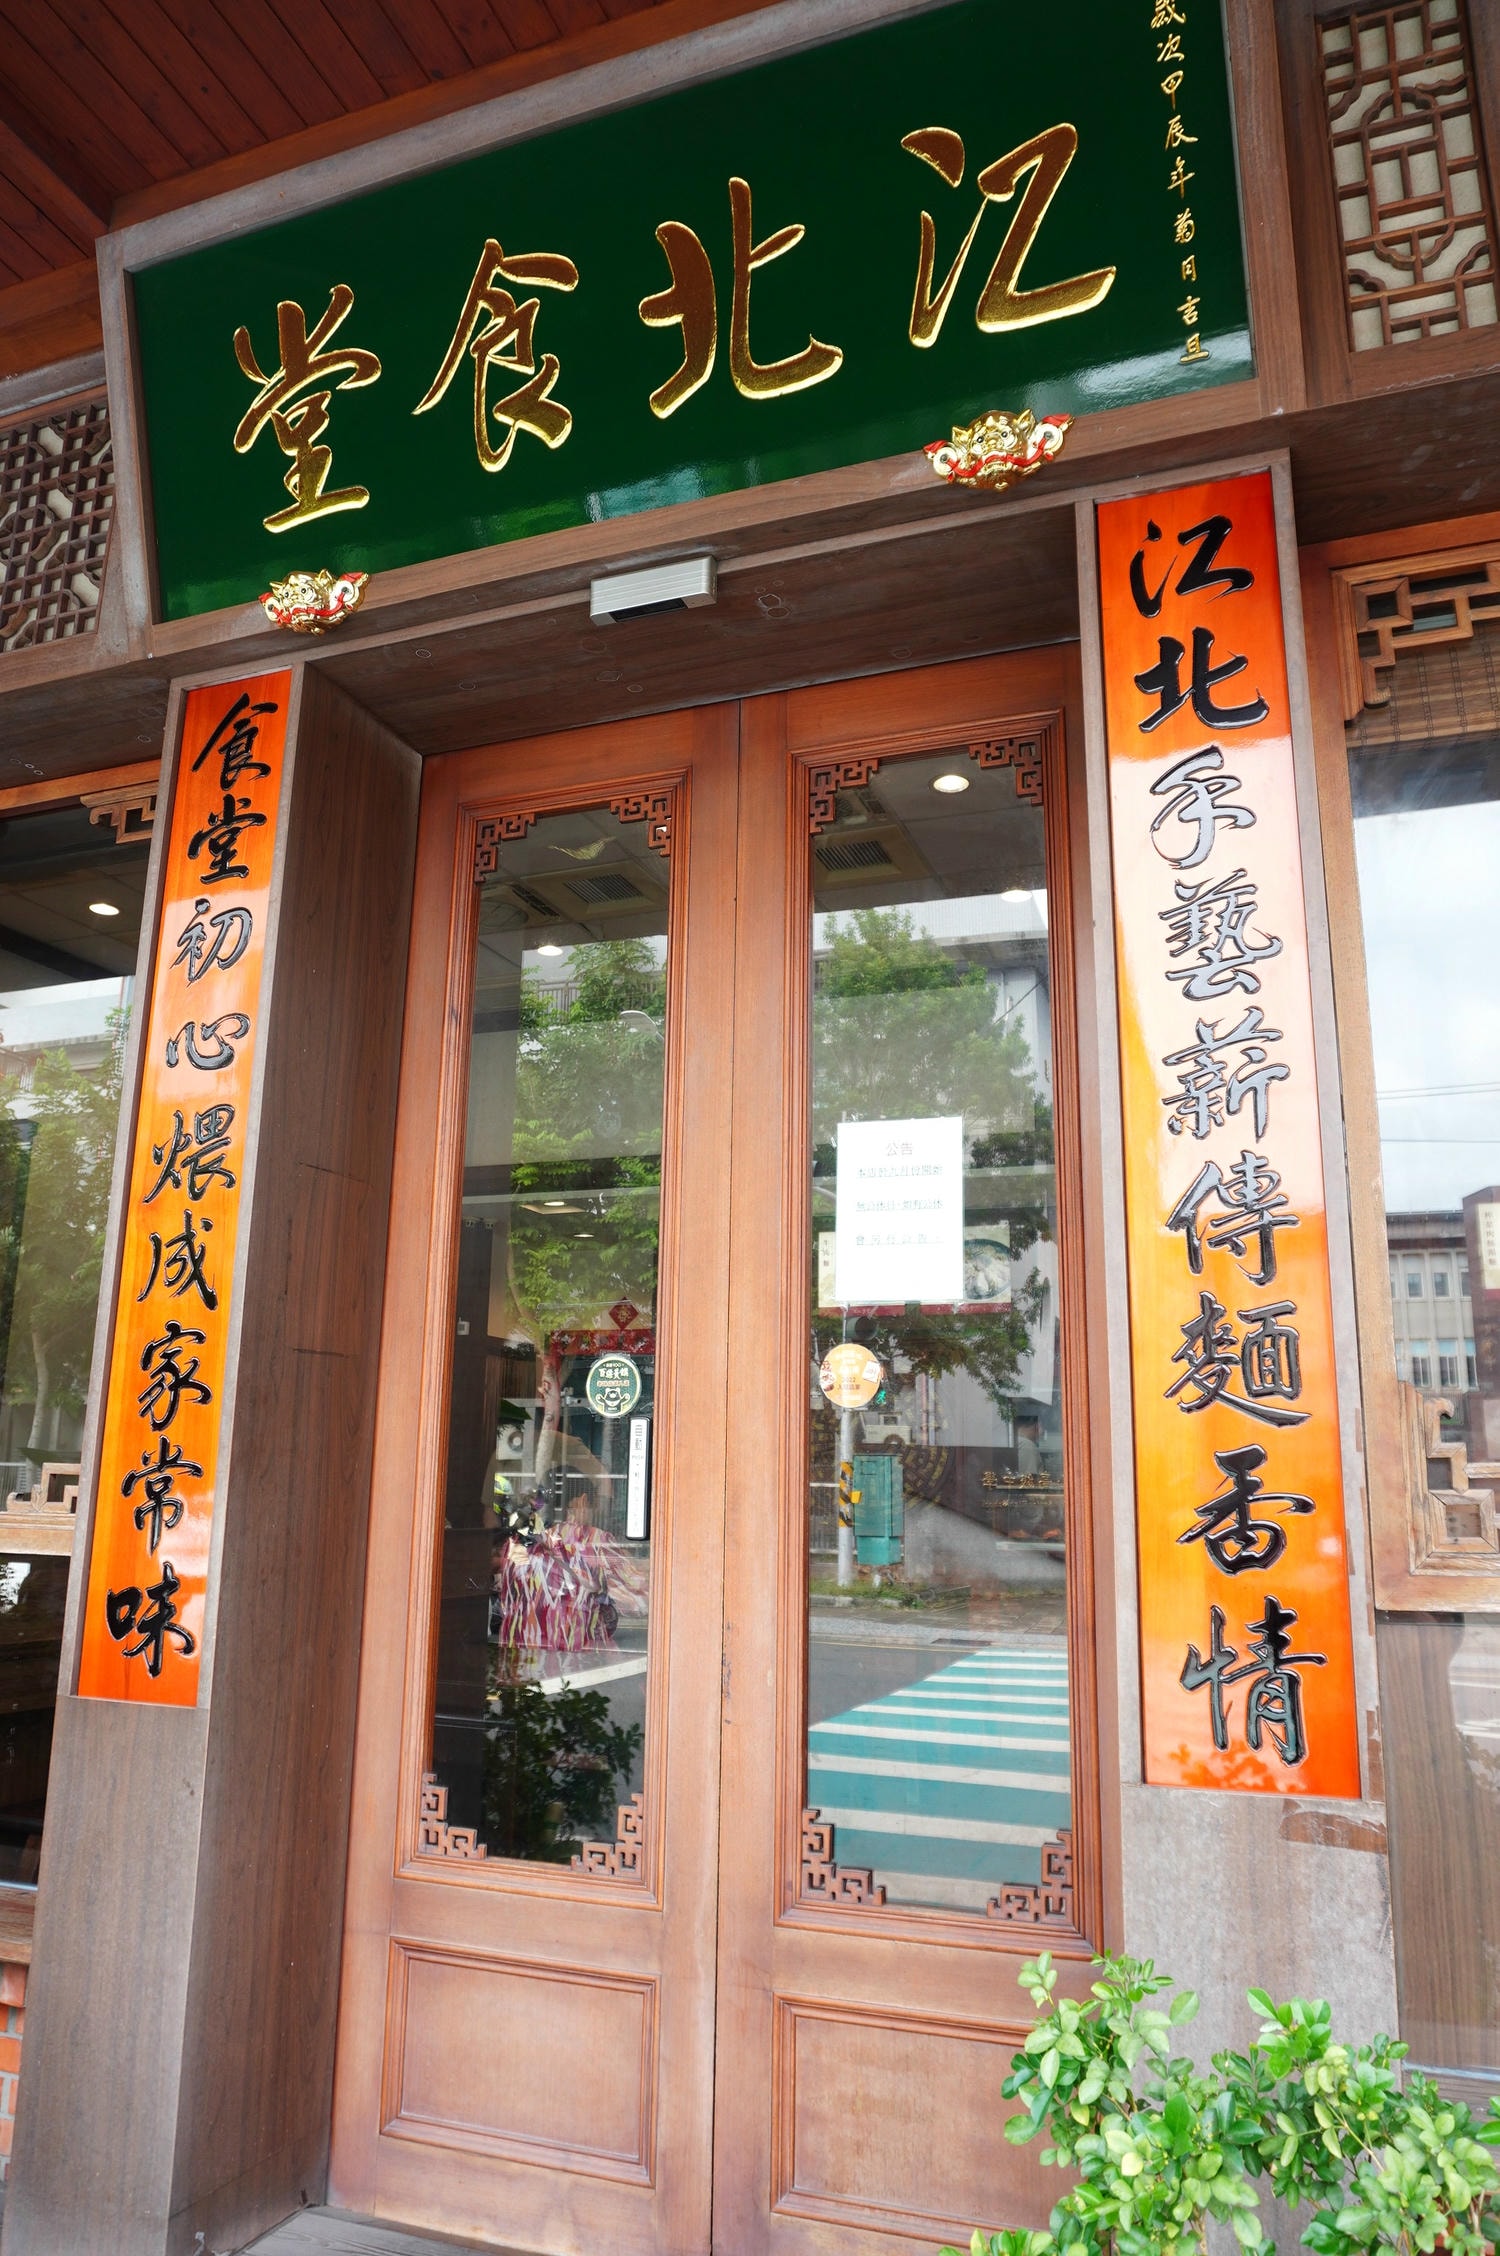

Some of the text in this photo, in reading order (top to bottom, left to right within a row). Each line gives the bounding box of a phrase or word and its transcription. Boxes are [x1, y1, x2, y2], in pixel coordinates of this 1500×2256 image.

[232, 122, 1117, 535] 江北食堂
[105, 692, 279, 1679] 食堂初心煨成家常味
[885, 1141, 914, 1157] 公告
[1128, 514, 1328, 1768] 江北手藝薪傳麵香情
